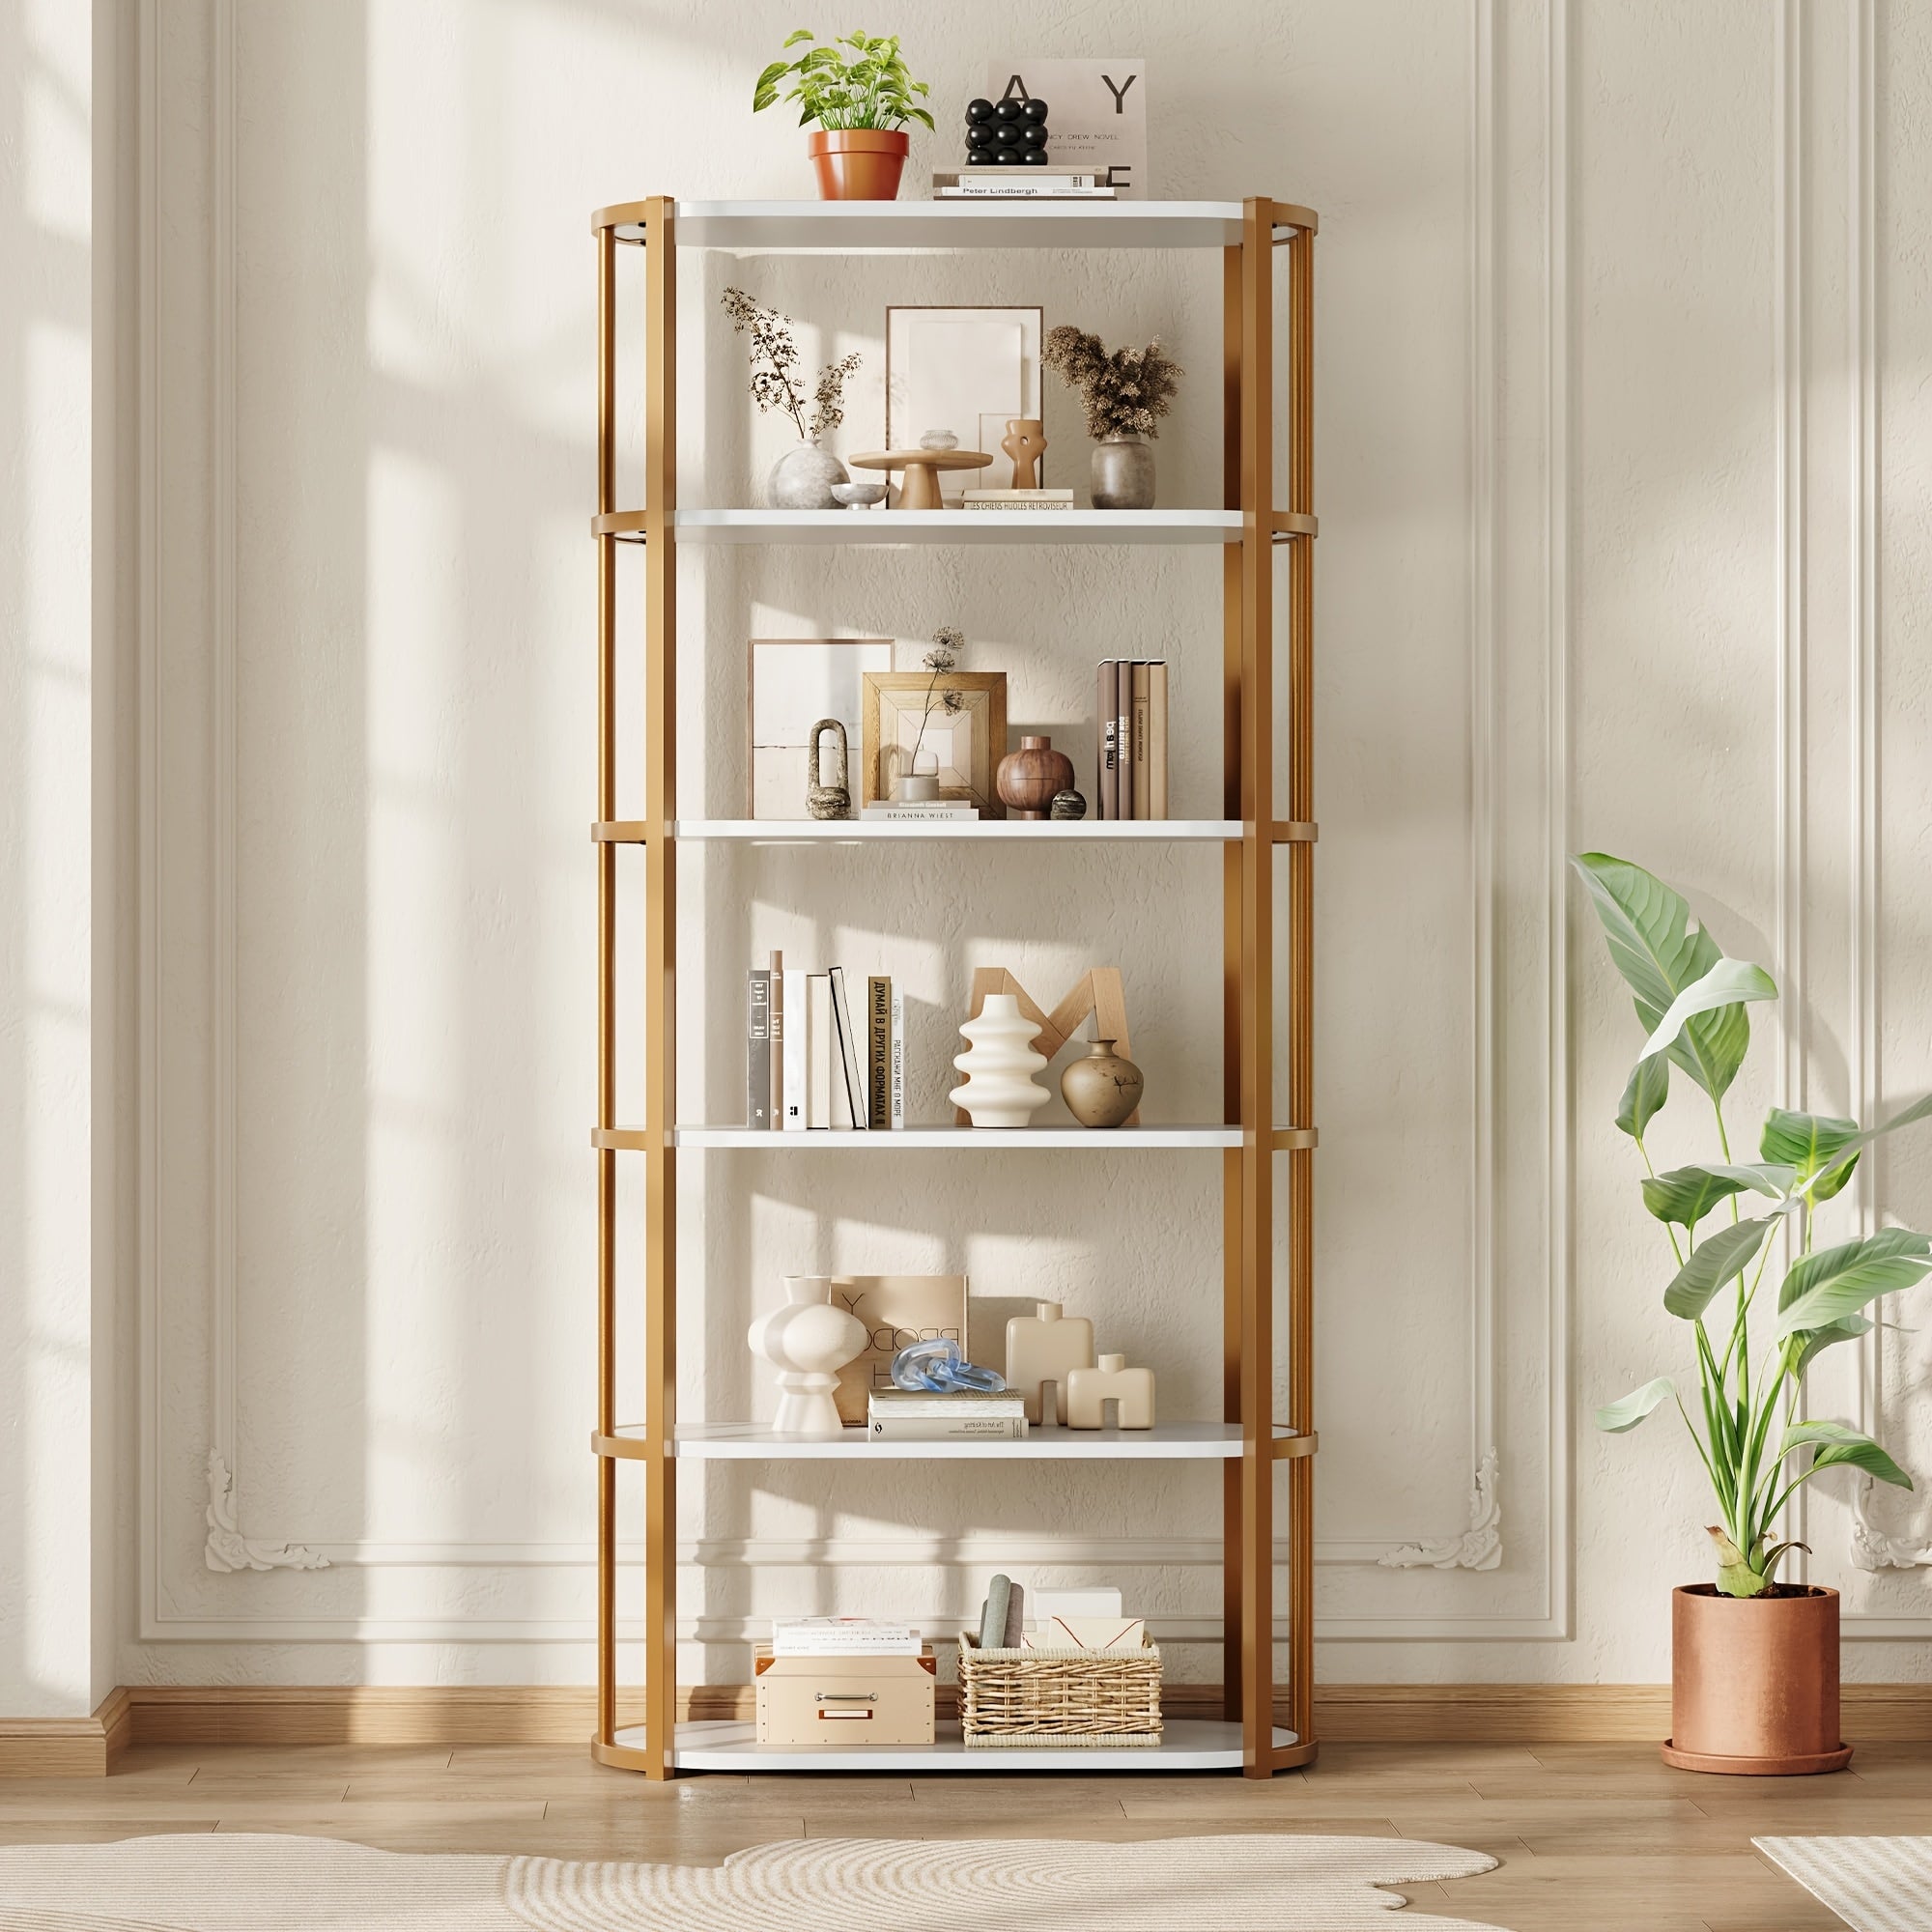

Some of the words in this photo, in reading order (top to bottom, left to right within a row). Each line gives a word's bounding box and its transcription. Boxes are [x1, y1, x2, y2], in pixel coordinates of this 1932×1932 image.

[1100, 74, 1137, 114] Y
[874, 981, 888, 1015] ДУМАЙ
[874, 1026, 886, 1064] ДРУГИХ
[874, 1065, 886, 1116] ФОРМАТАХ
